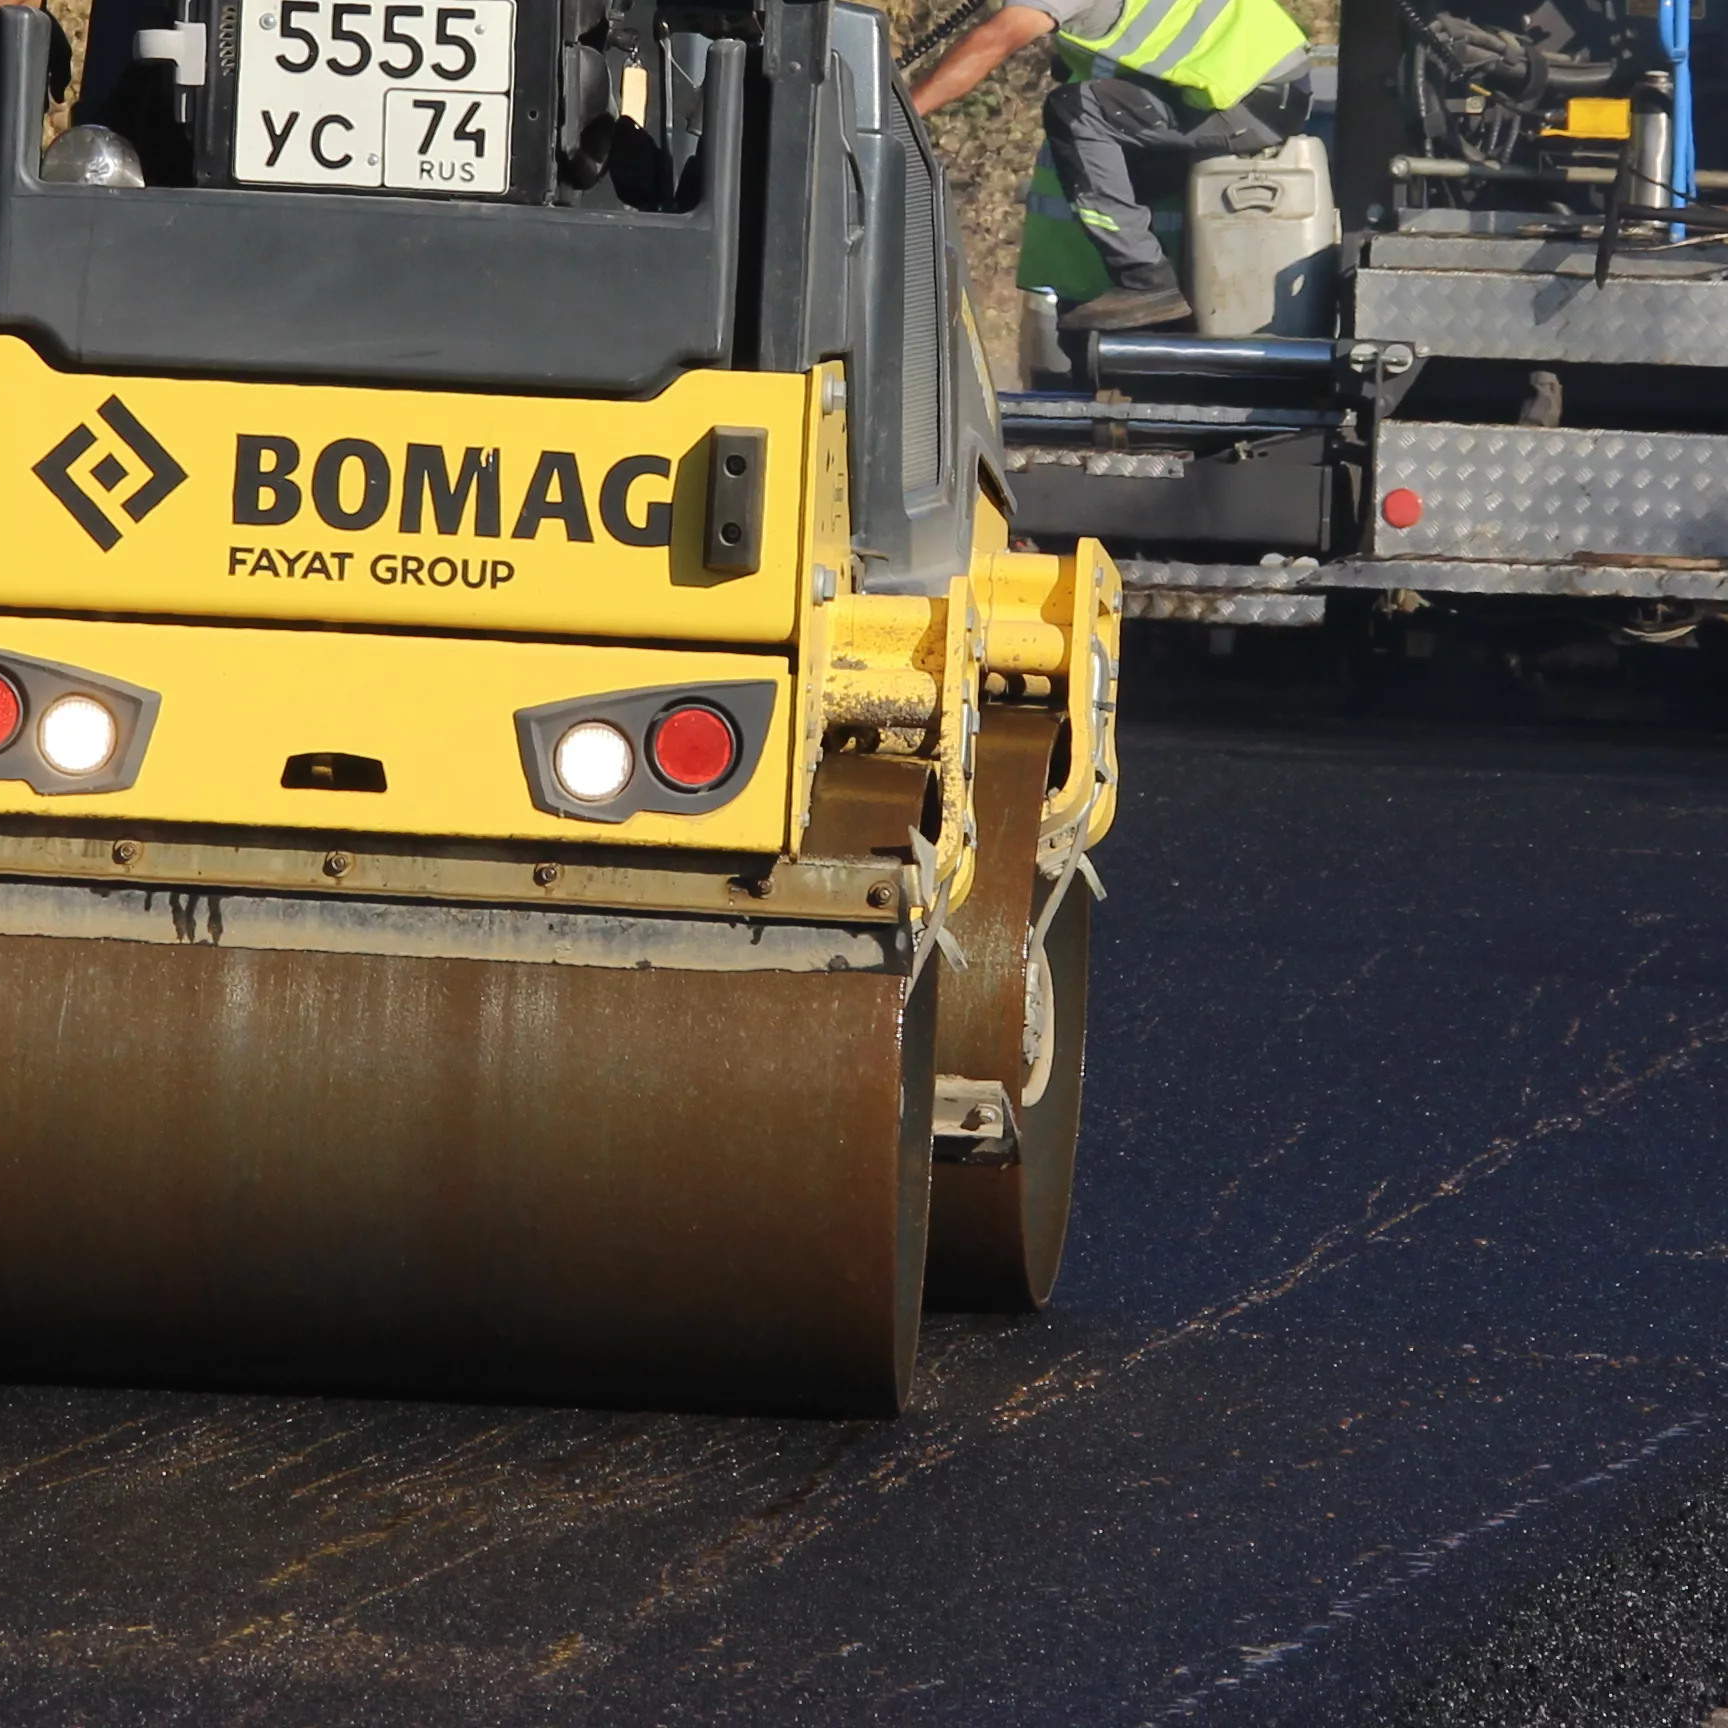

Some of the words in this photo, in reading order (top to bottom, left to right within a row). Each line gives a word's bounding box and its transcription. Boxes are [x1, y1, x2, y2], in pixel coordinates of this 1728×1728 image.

[275, 0, 476, 81] 5555
[261, 110, 354, 169] УС
[413, 99, 486, 158] 74
[419, 161, 476, 182] RUS
[232, 433, 672, 547] BOMAG
[228, 546, 354, 581] FAYAT
[370, 554, 515, 589] GROUP
